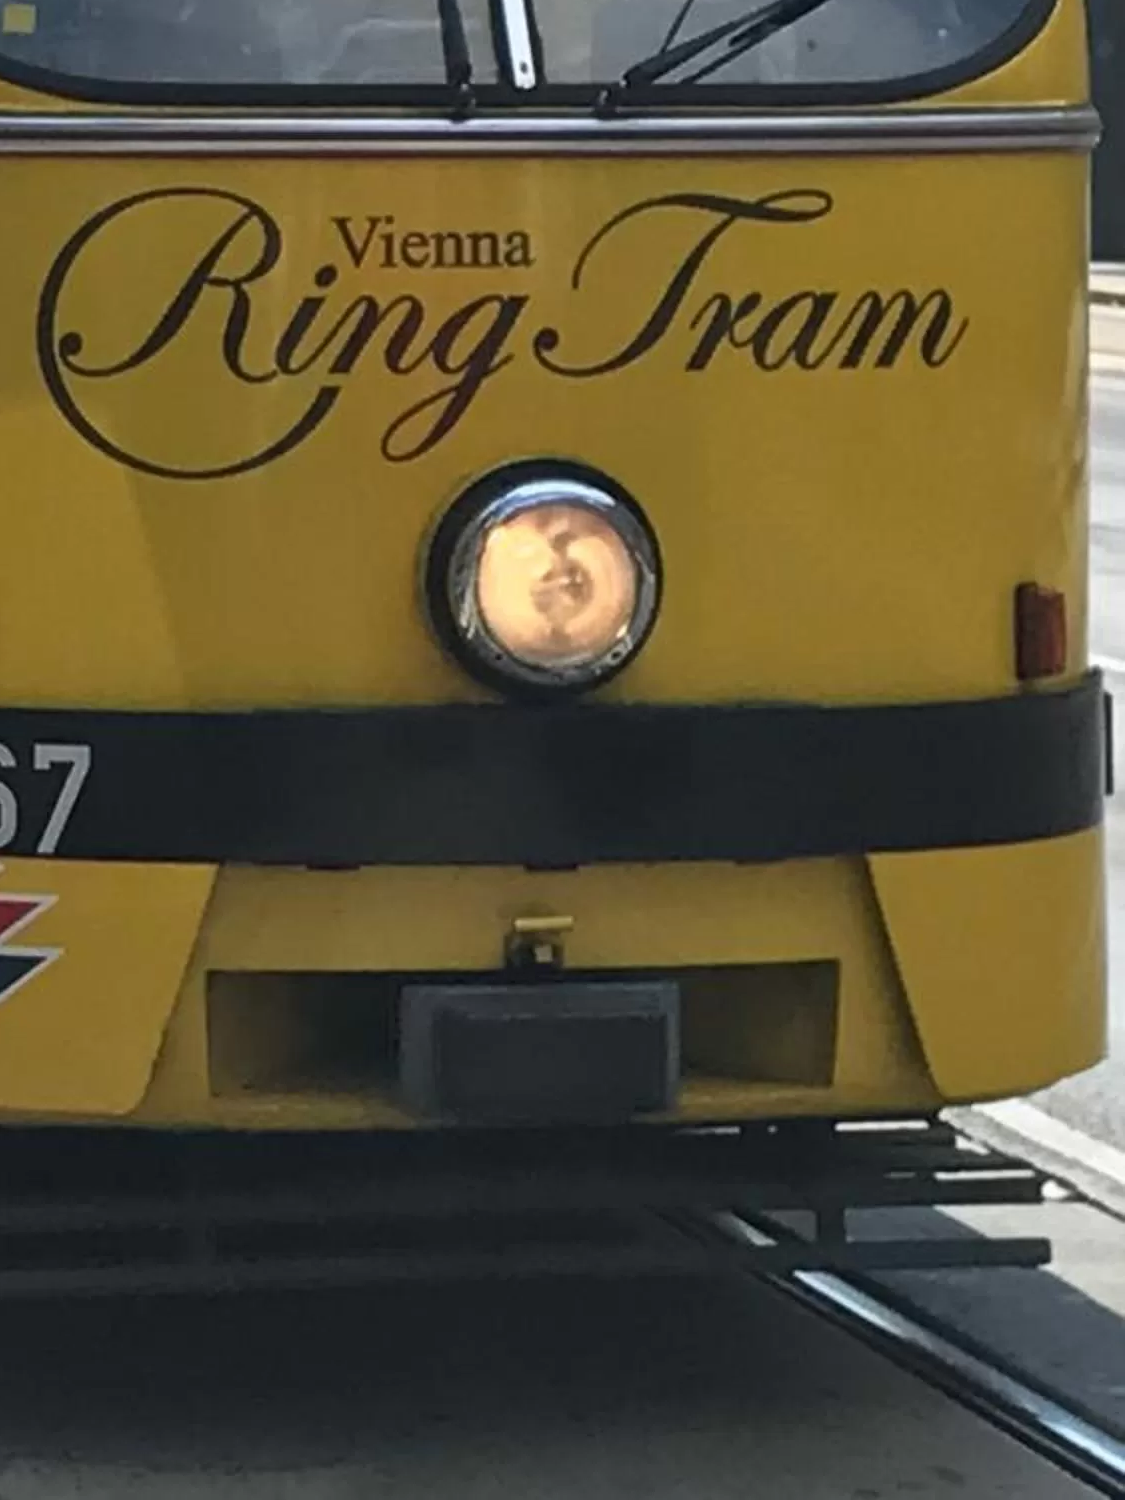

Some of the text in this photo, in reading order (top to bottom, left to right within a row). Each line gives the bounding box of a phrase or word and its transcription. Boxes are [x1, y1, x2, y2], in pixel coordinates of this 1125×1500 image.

[331, 215, 536, 269] Vienna
[36, 186, 969, 479] Ring Tram
